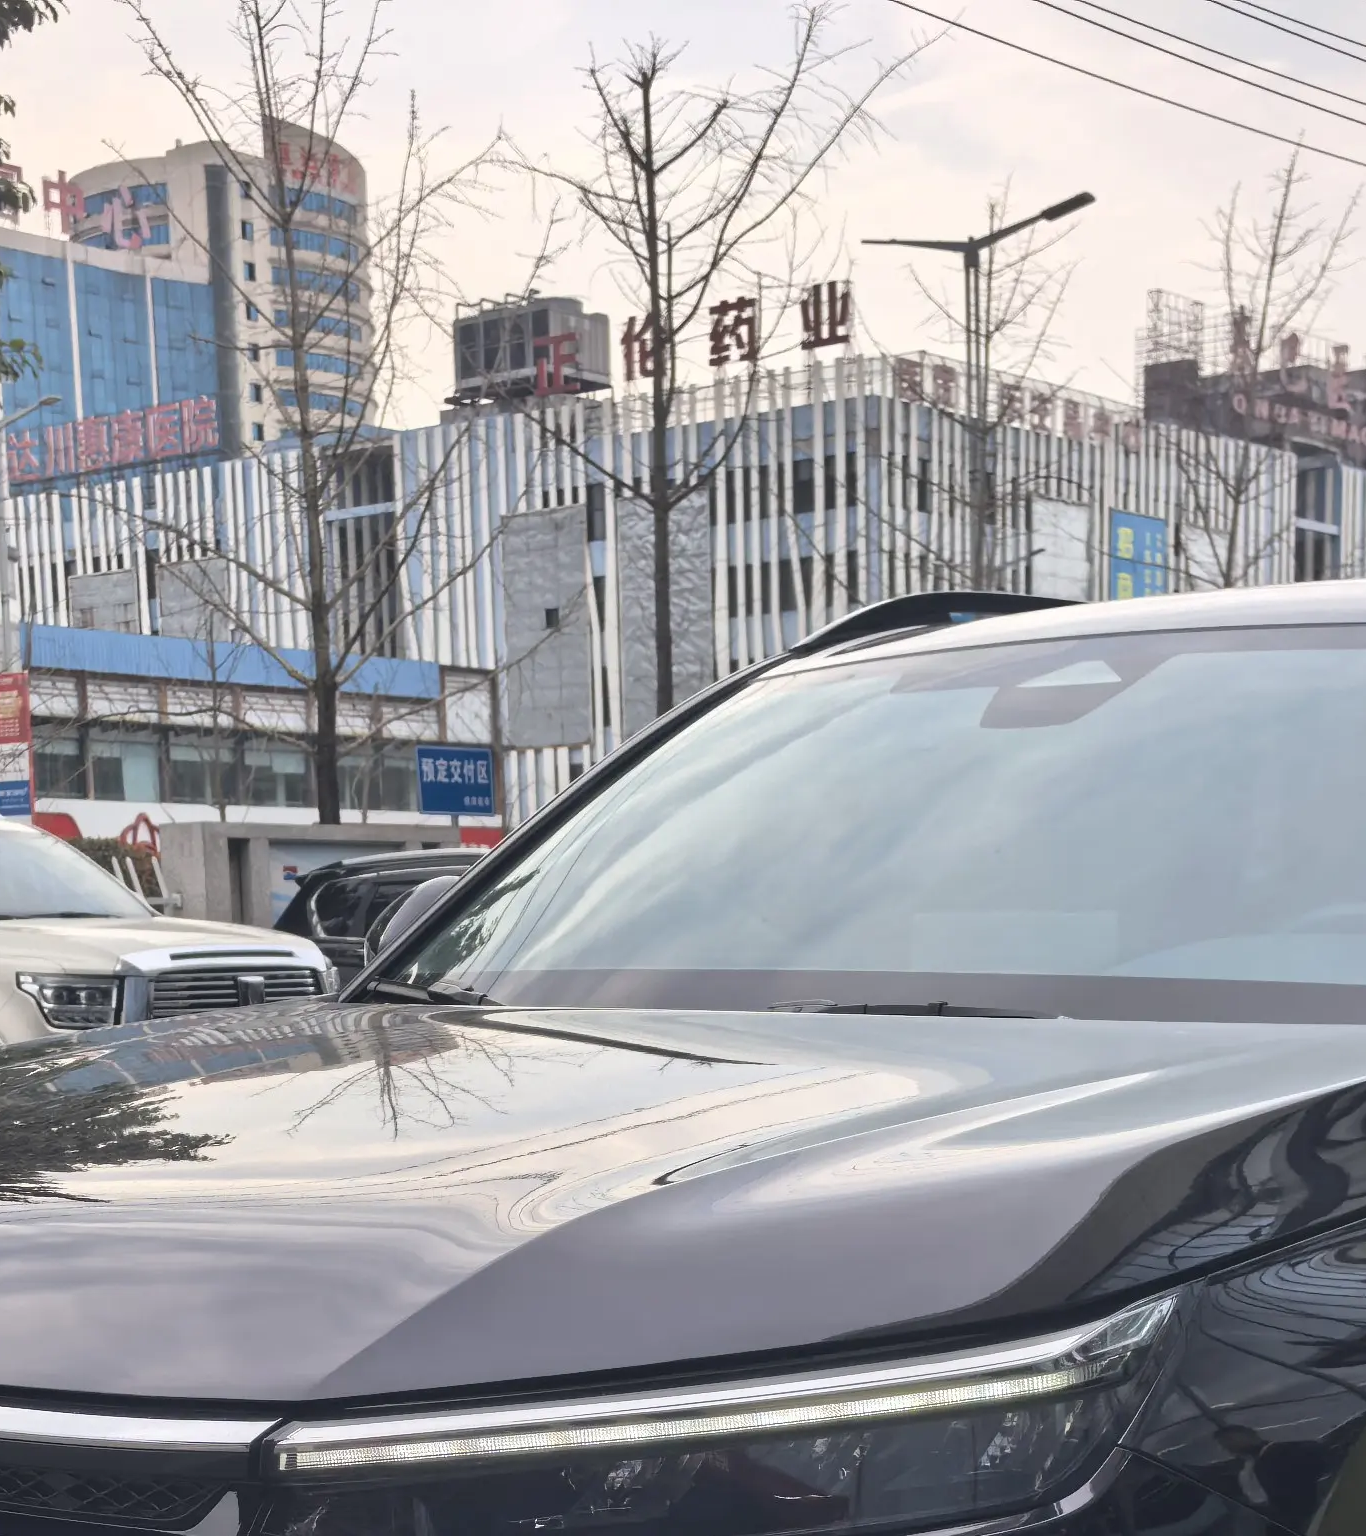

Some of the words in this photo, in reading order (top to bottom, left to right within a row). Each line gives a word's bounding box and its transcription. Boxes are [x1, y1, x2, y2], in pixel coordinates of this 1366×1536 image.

[420, 757, 489, 784] 预定交付区
